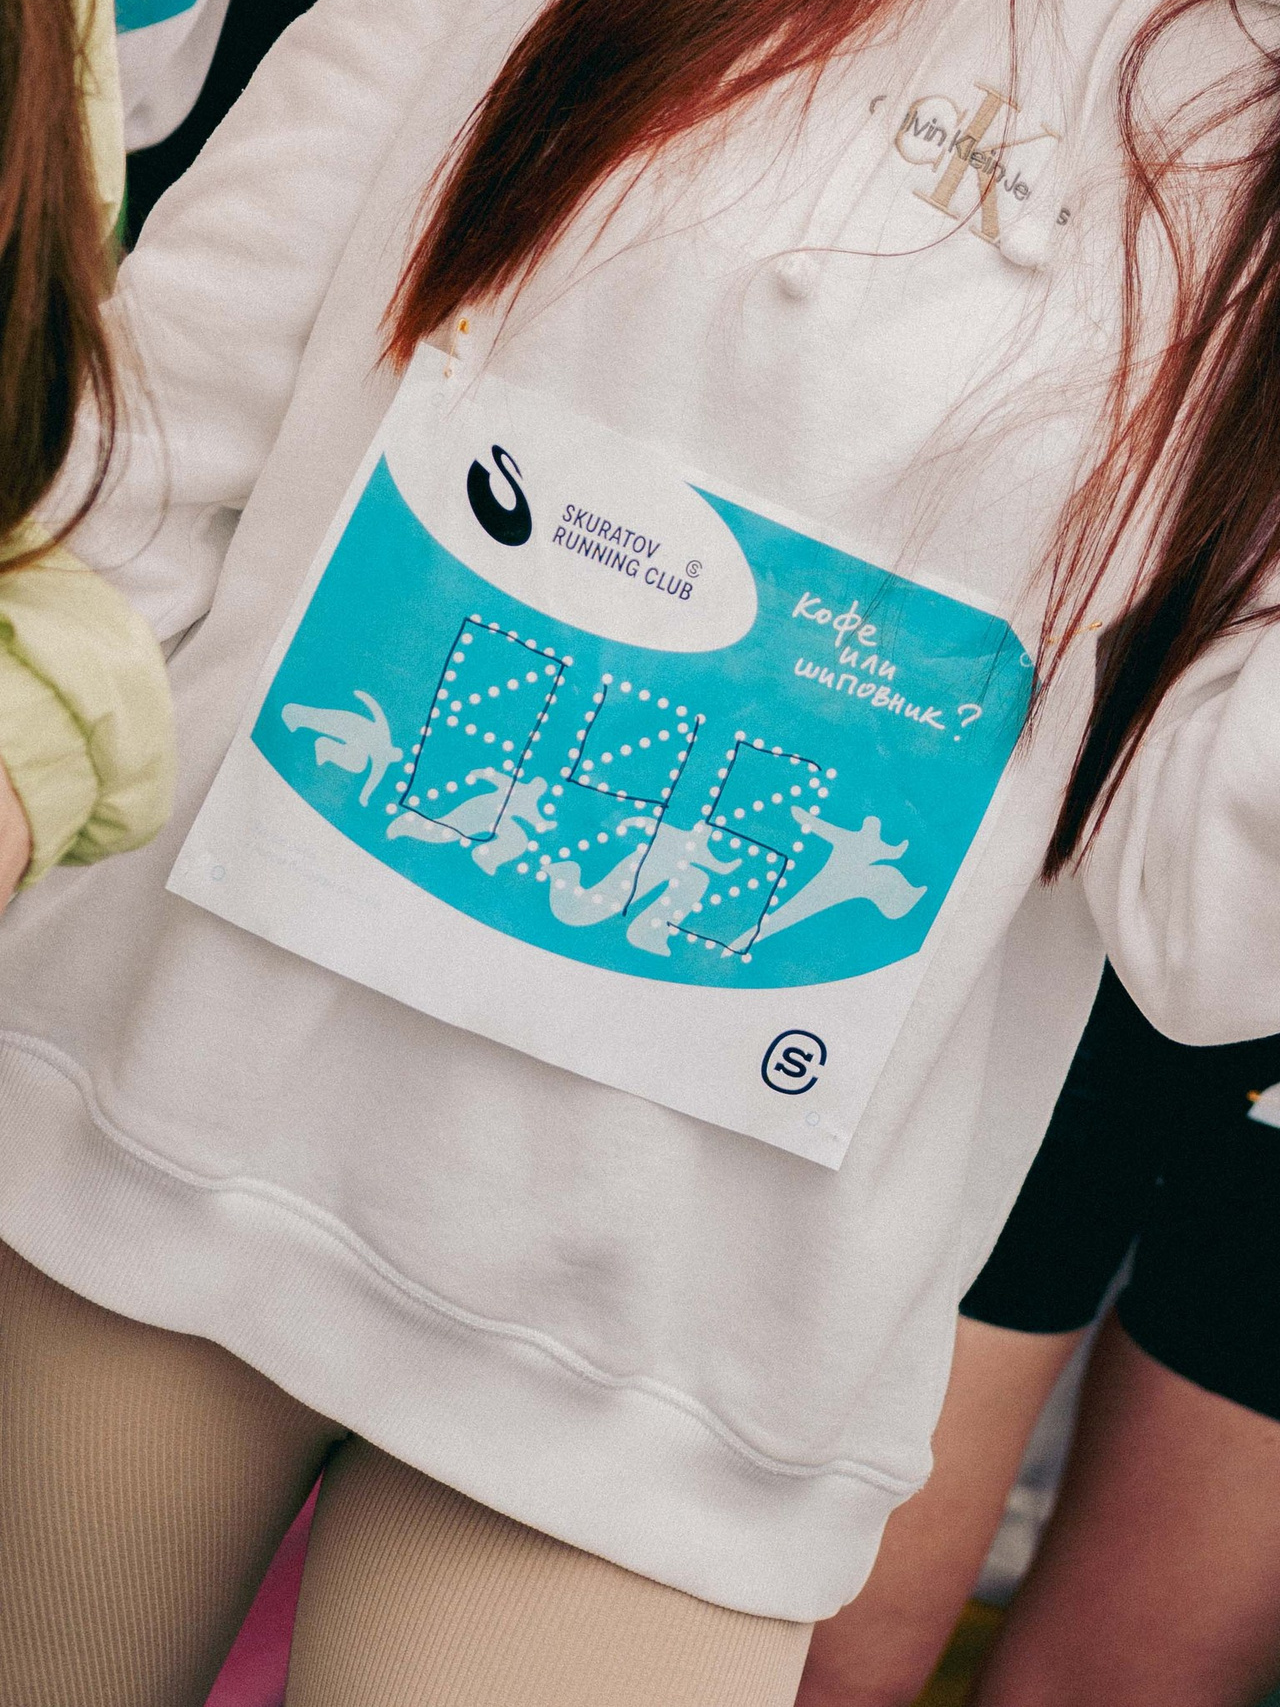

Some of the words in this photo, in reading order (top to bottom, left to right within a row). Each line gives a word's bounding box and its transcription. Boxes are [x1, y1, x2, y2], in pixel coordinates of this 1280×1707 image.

[562, 504, 661, 558] SKURATOV
[552, 526, 640, 578] RUNNING
[645, 567, 693, 600] CLUB
[791, 591, 877, 647] Кофе
[839, 646, 897, 681] или
